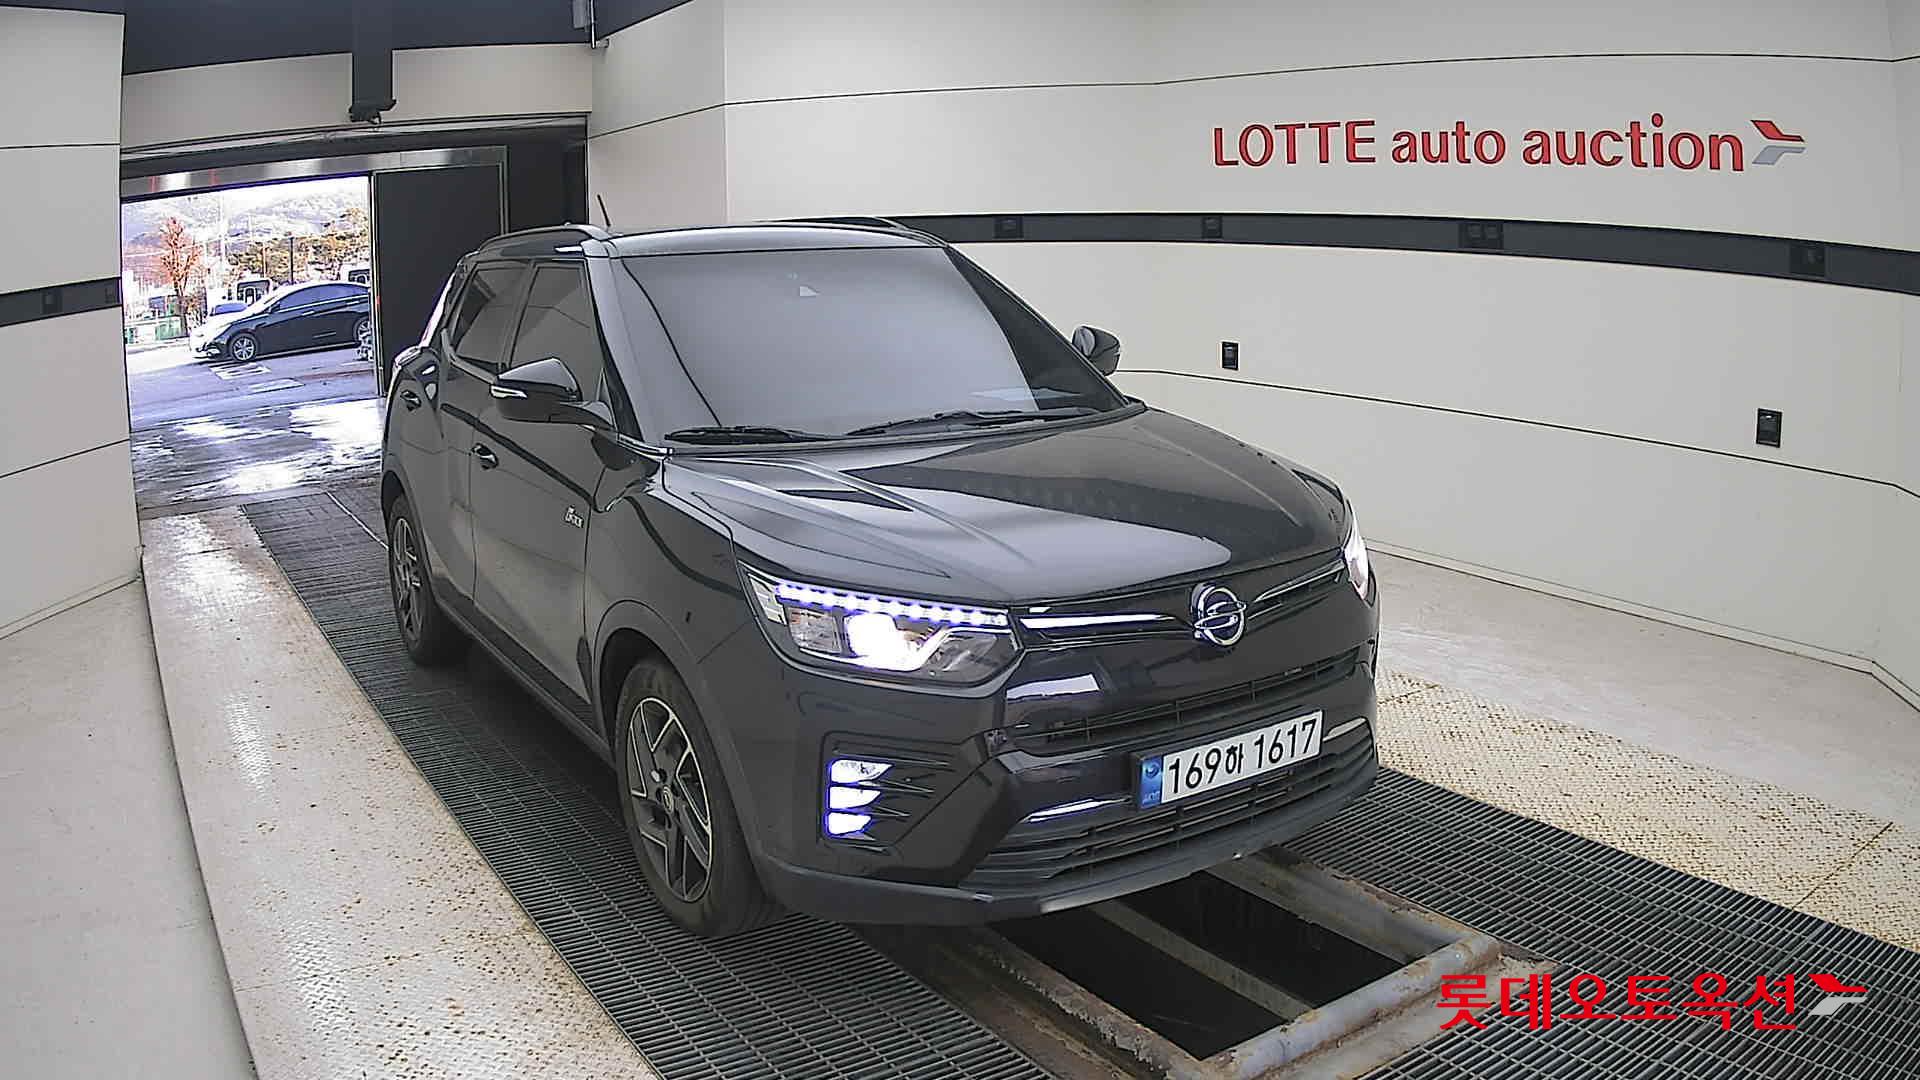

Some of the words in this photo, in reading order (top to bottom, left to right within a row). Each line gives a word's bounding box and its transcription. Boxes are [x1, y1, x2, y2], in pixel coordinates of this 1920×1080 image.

[1213, 120, 1376, 167] LOTTE
[1391, 121, 1507, 164] auto
[1522, 113, 1745, 172] auction
[1168, 743, 1244, 793] 169하
[1254, 719, 1317, 768] 1617
